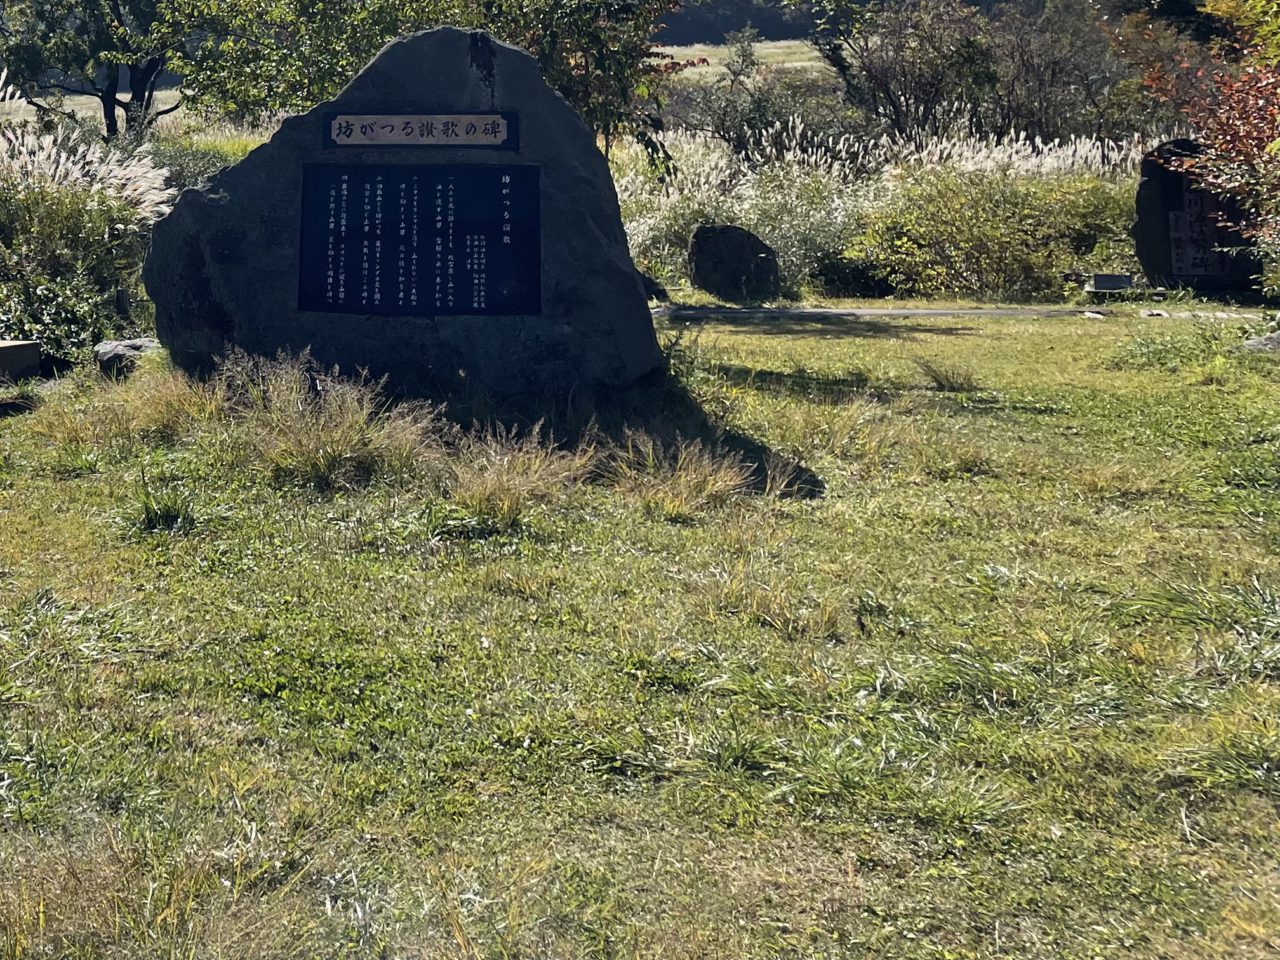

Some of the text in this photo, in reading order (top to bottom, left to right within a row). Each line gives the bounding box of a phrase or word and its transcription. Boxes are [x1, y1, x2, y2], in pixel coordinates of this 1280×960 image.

[336, 120, 501, 139] 坊がつる讃歌の碑
